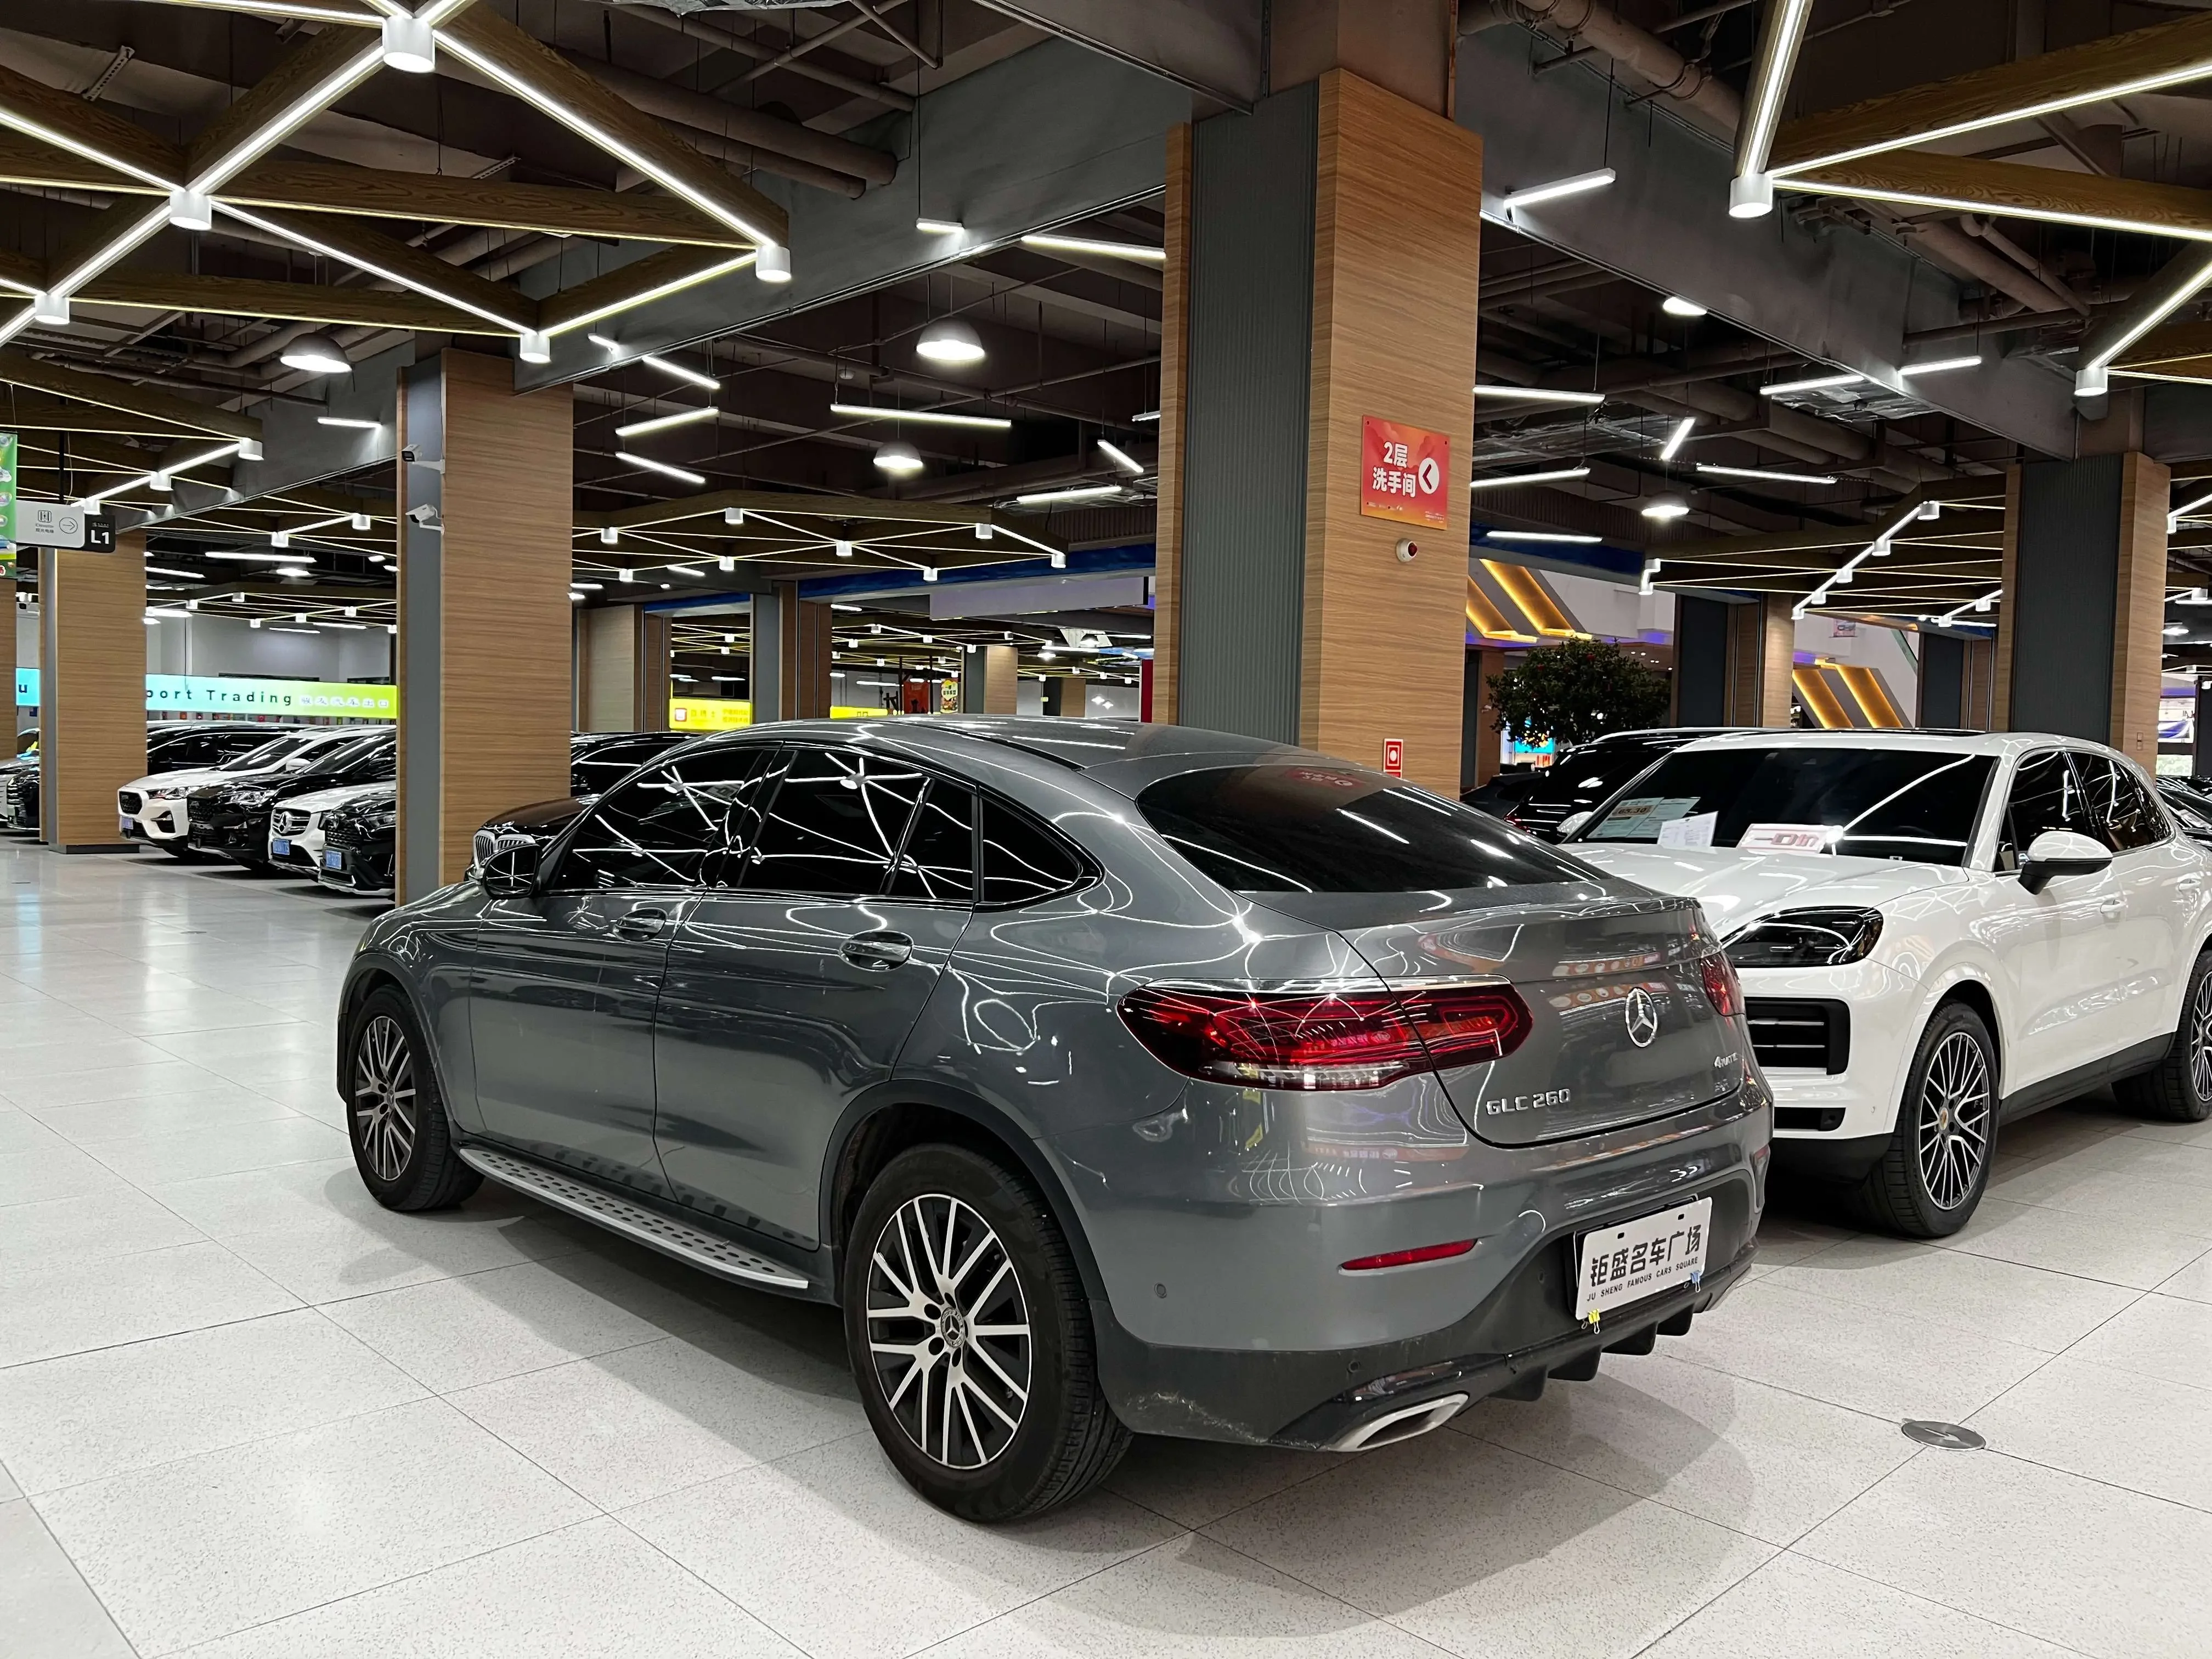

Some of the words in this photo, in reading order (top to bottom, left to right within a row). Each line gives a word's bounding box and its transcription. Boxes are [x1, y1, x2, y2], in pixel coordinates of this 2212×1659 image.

[1383, 441, 1408, 468] 2层
[1372, 466, 1417, 498] 洗手间
[91, 529, 110, 545] L1
[206, 689, 292, 706] Trading
[1486, 1095, 1529, 1115] GLC
[1532, 1088, 1571, 1109] 260
[1587, 1291, 1596, 1302] JU
[1600, 1283, 1623, 1297] SHENG
[1627, 1272, 1652, 1288] FAMOUS
[1656, 1266, 1672, 1278] CARS
[1675, 1256, 1699, 1271] SQUARE
